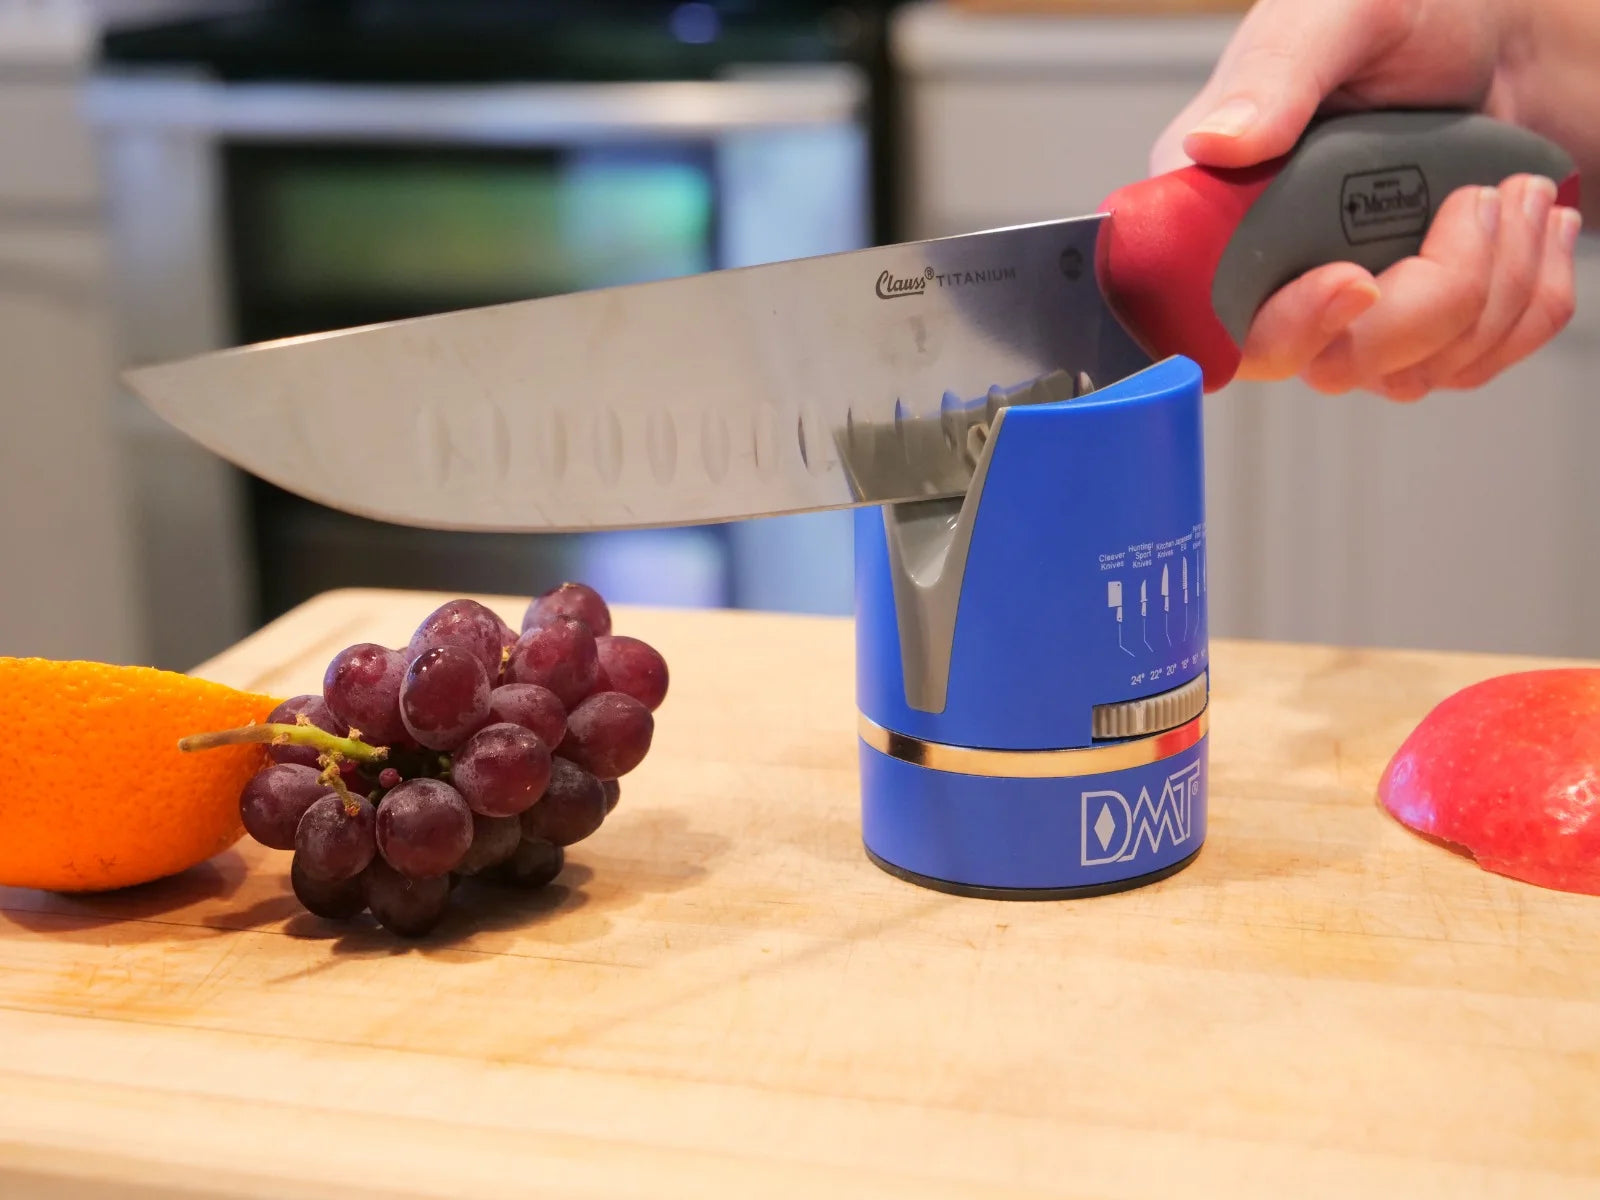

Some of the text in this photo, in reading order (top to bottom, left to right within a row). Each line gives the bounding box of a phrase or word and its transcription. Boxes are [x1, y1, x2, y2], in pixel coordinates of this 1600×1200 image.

[936, 267, 1017, 287] TITANIUM
[1156, 540, 1175, 551] Kitchen
[1098, 552, 1126, 563] Cleaver
[1135, 550, 1152, 561] Sport
[1157, 549, 1174, 559] Knives
[1100, 560, 1125, 571] Knives
[1132, 559, 1152, 569] Knives
